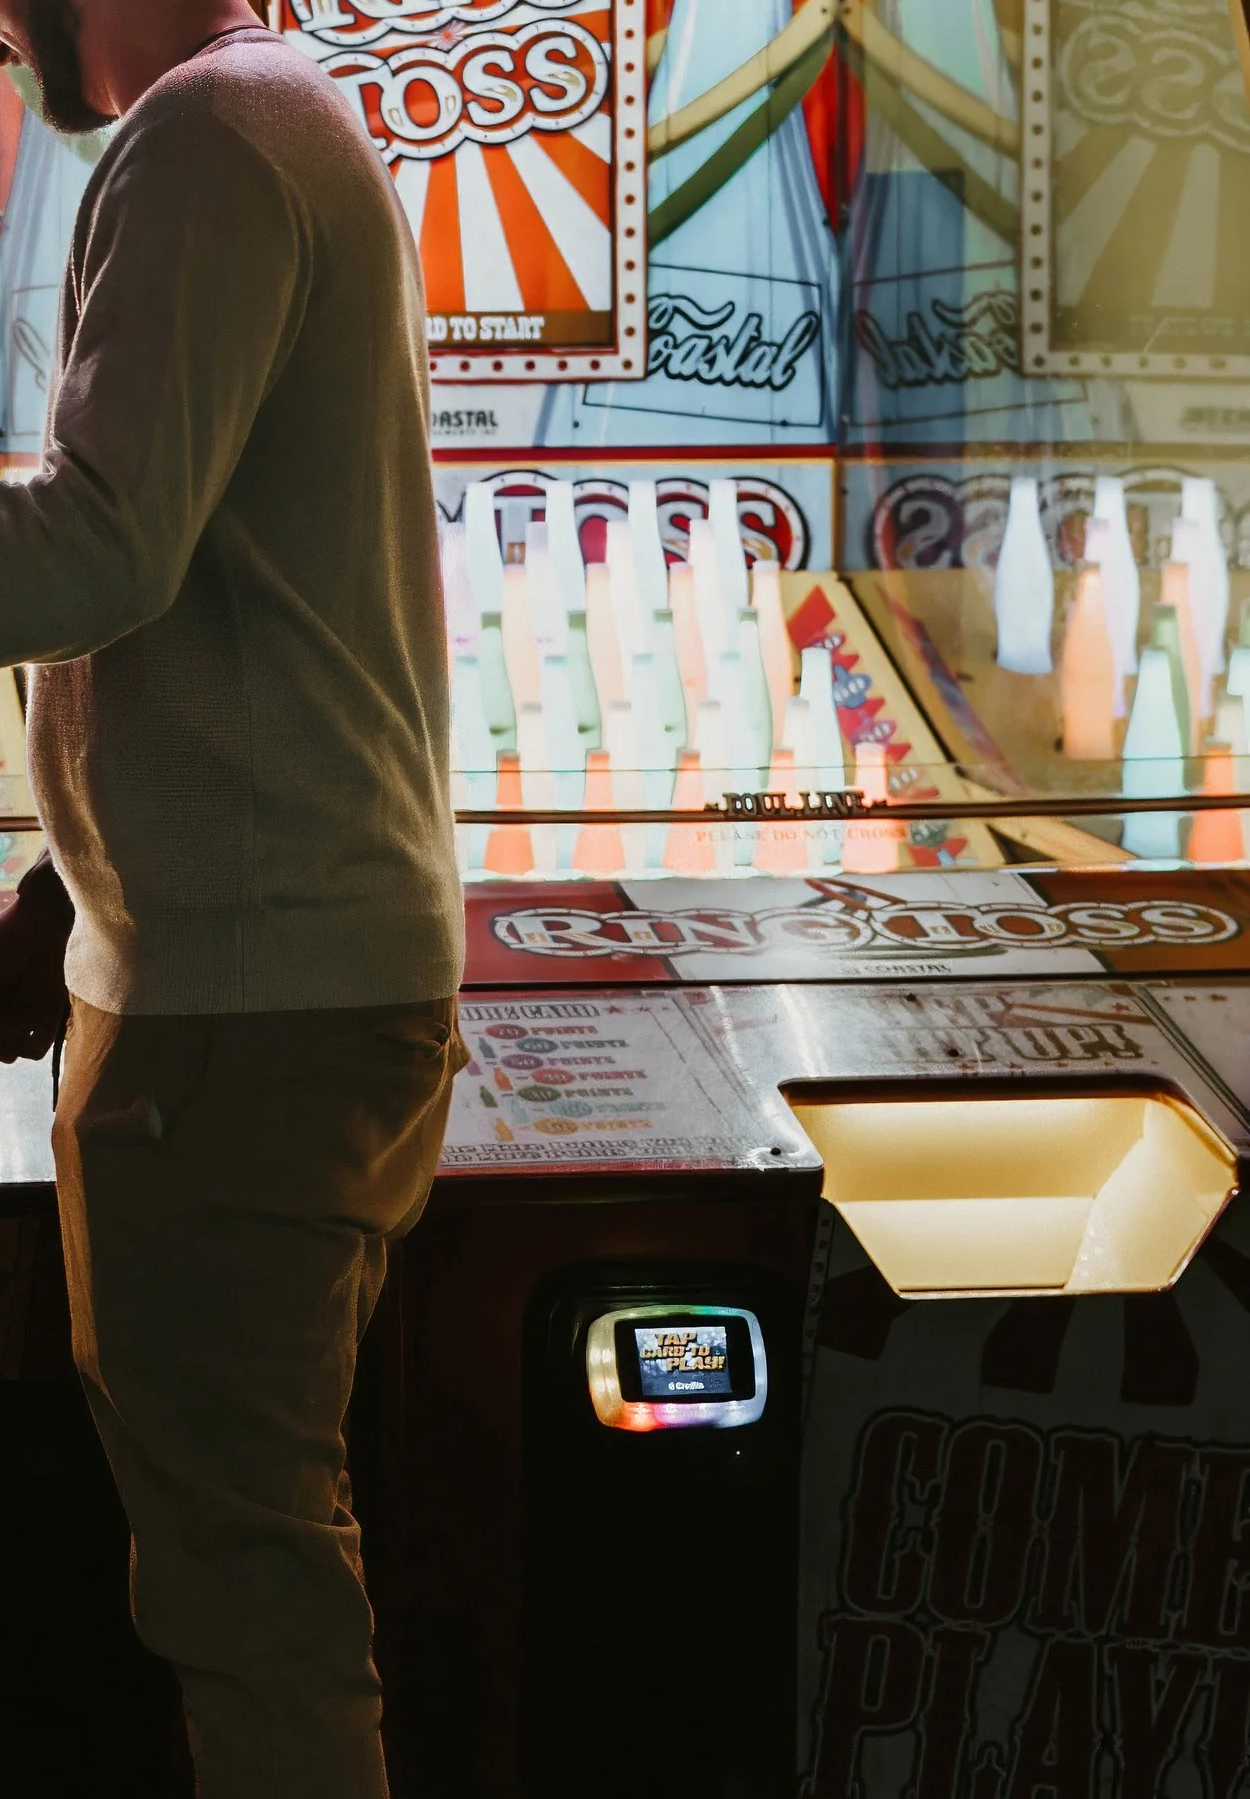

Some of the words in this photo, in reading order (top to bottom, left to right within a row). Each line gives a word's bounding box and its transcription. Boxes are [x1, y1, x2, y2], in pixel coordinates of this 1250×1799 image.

[333, 36, 587, 150] TOSS
[449, 315, 477, 340] TO
[479, 315, 545, 340] START
[799, 792, 869, 816] LINE
[773, 829, 797, 841] DO
[803, 828, 840, 841] NOT
[509, 913, 858, 950] RING
[870, 906, 1214, 943] TOSS
[656, 1332, 698, 1346] TAP
[640, 1346, 686, 1358] CARD
[691, 1345, 711, 1356] TO
[667, 1356, 726, 1371] PLAY!
